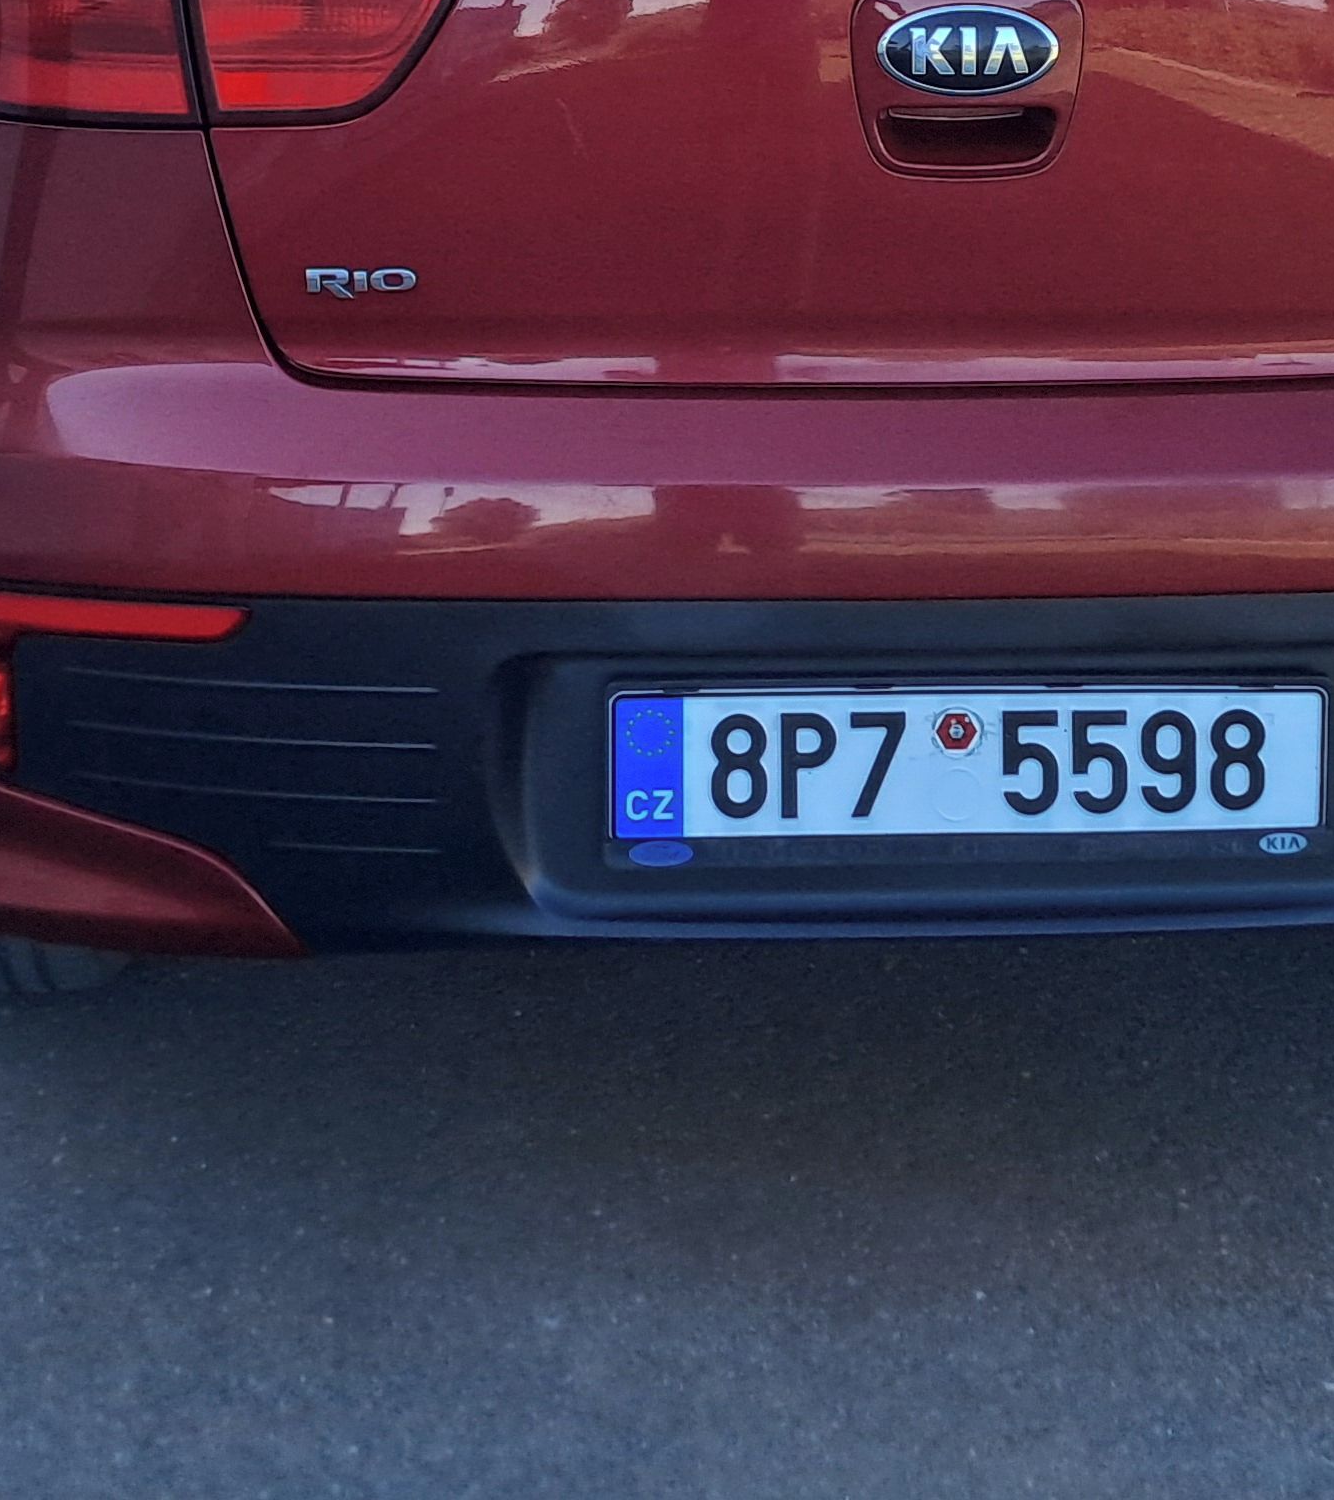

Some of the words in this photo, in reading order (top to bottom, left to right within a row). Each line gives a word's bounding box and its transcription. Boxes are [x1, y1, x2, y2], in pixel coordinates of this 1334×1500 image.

[909, 26, 1029, 76] KIA
[305, 267, 417, 300] RIO
[709, 710, 907, 820] 8P7
[1000, 708, 1267, 816] 5598
[625, 789, 675, 821] CZ
[1266, 836, 1301, 851] KIA
